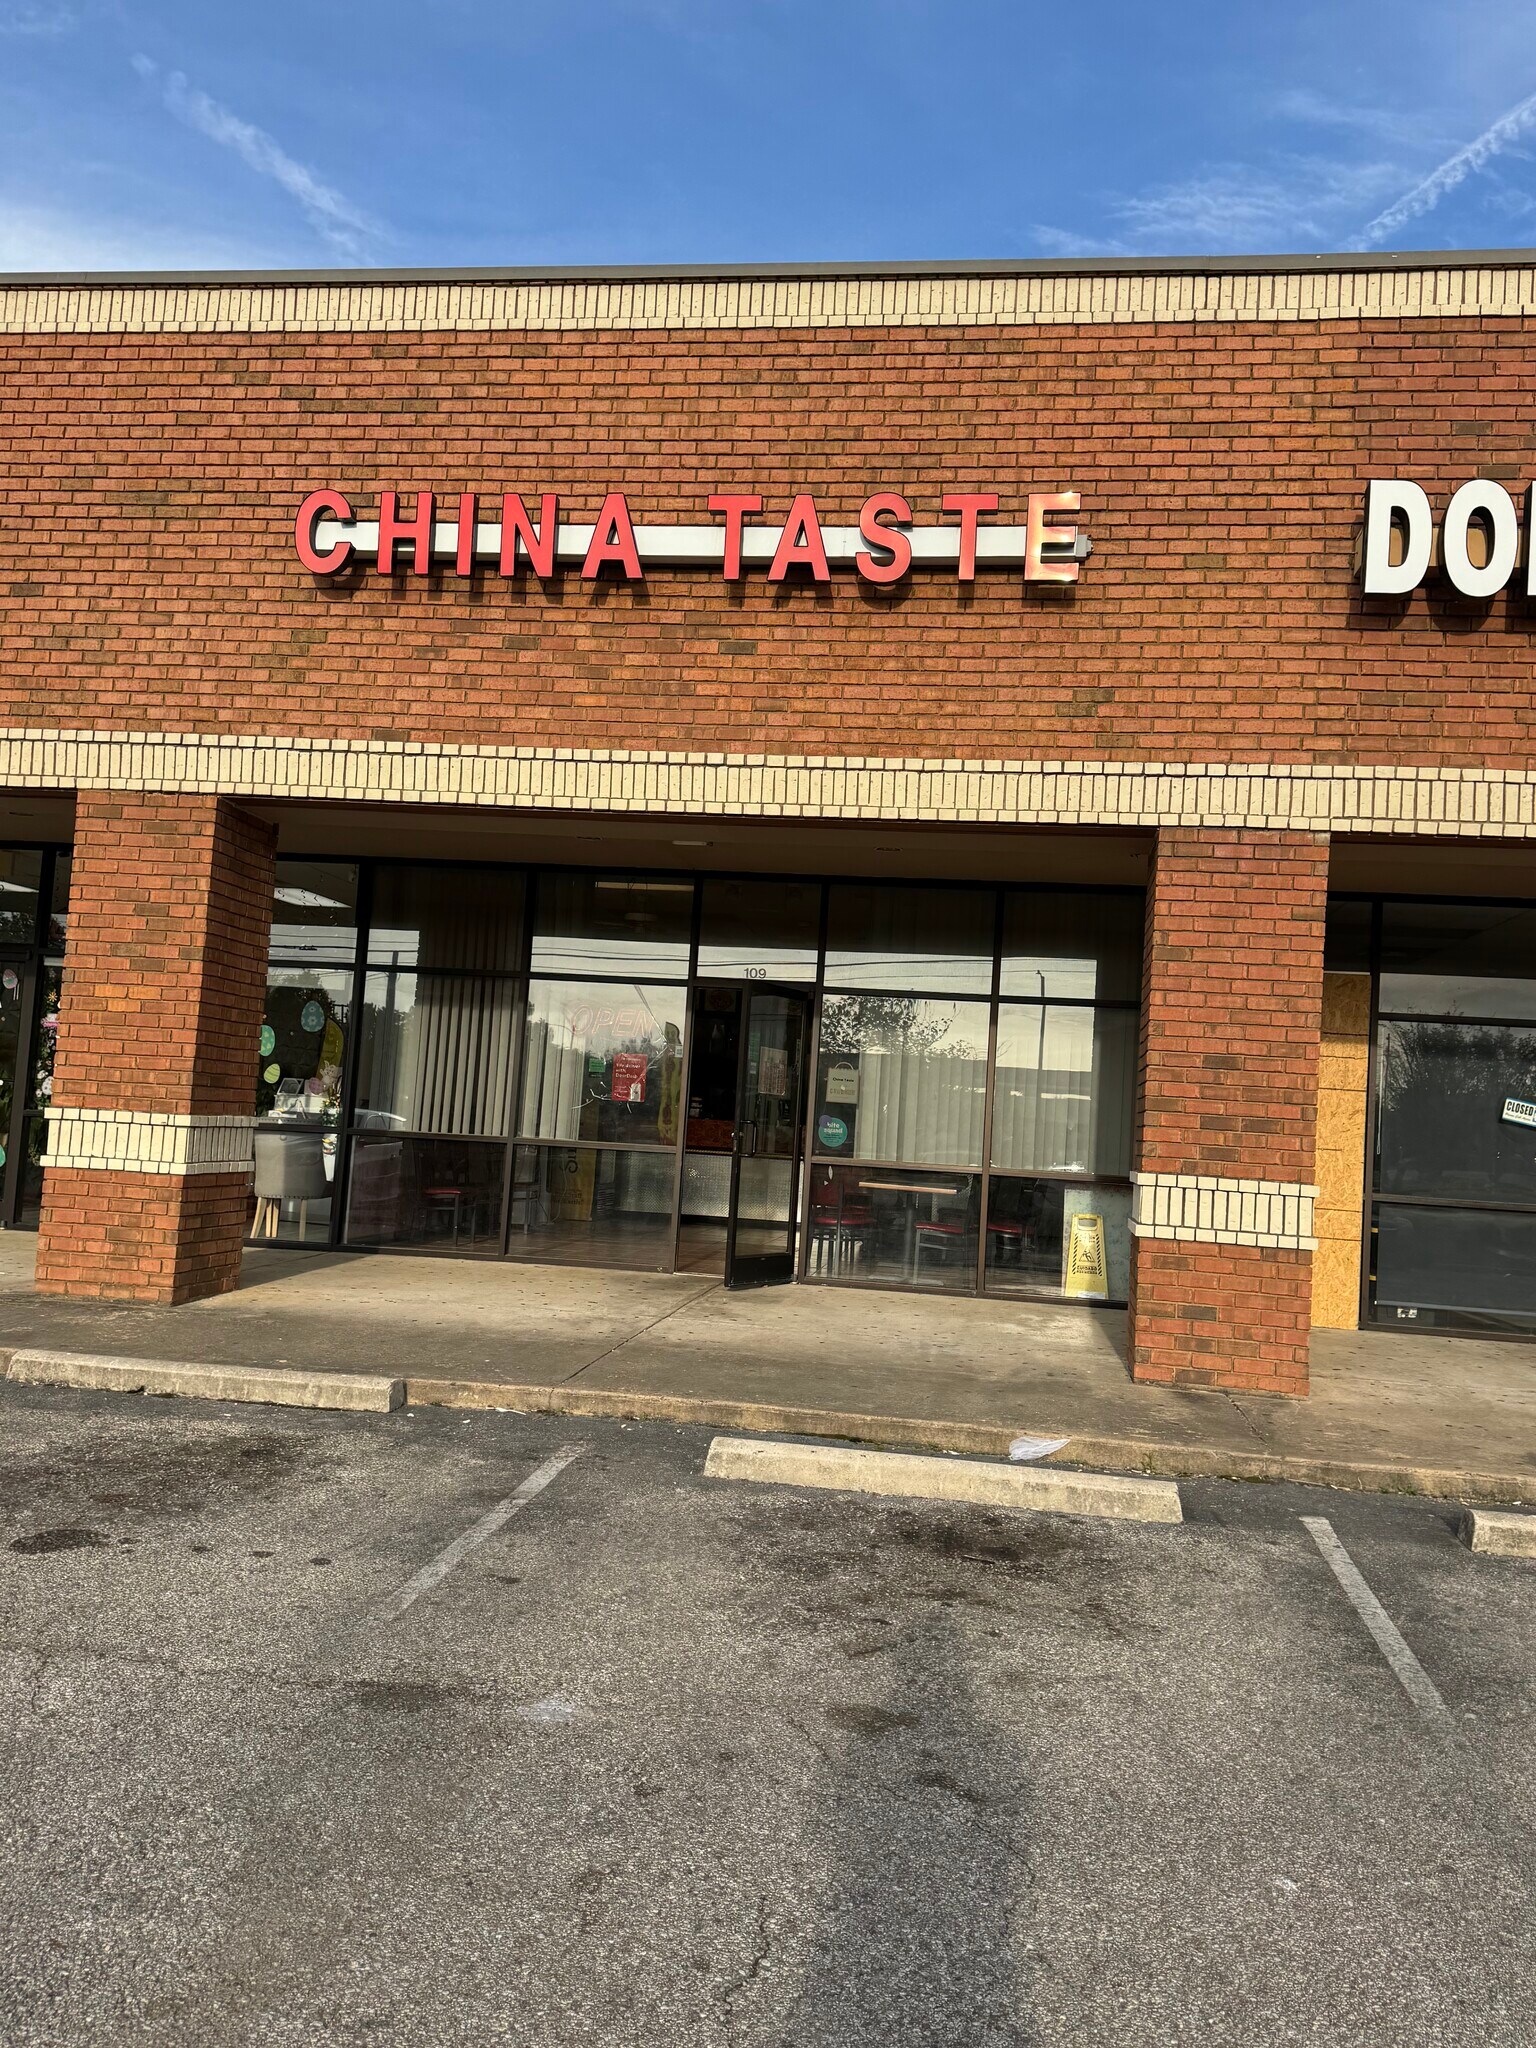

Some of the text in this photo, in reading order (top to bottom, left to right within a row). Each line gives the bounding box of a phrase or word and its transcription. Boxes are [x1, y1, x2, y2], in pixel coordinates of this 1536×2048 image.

[295, 489, 1082, 584] CHINA TASTE
[1361, 478, 1536, 598] DO
[744, 967, 767, 979] 109
[571, 1004, 657, 1038] OPEN
[1506, 1101, 1534, 1116] CLOSED
